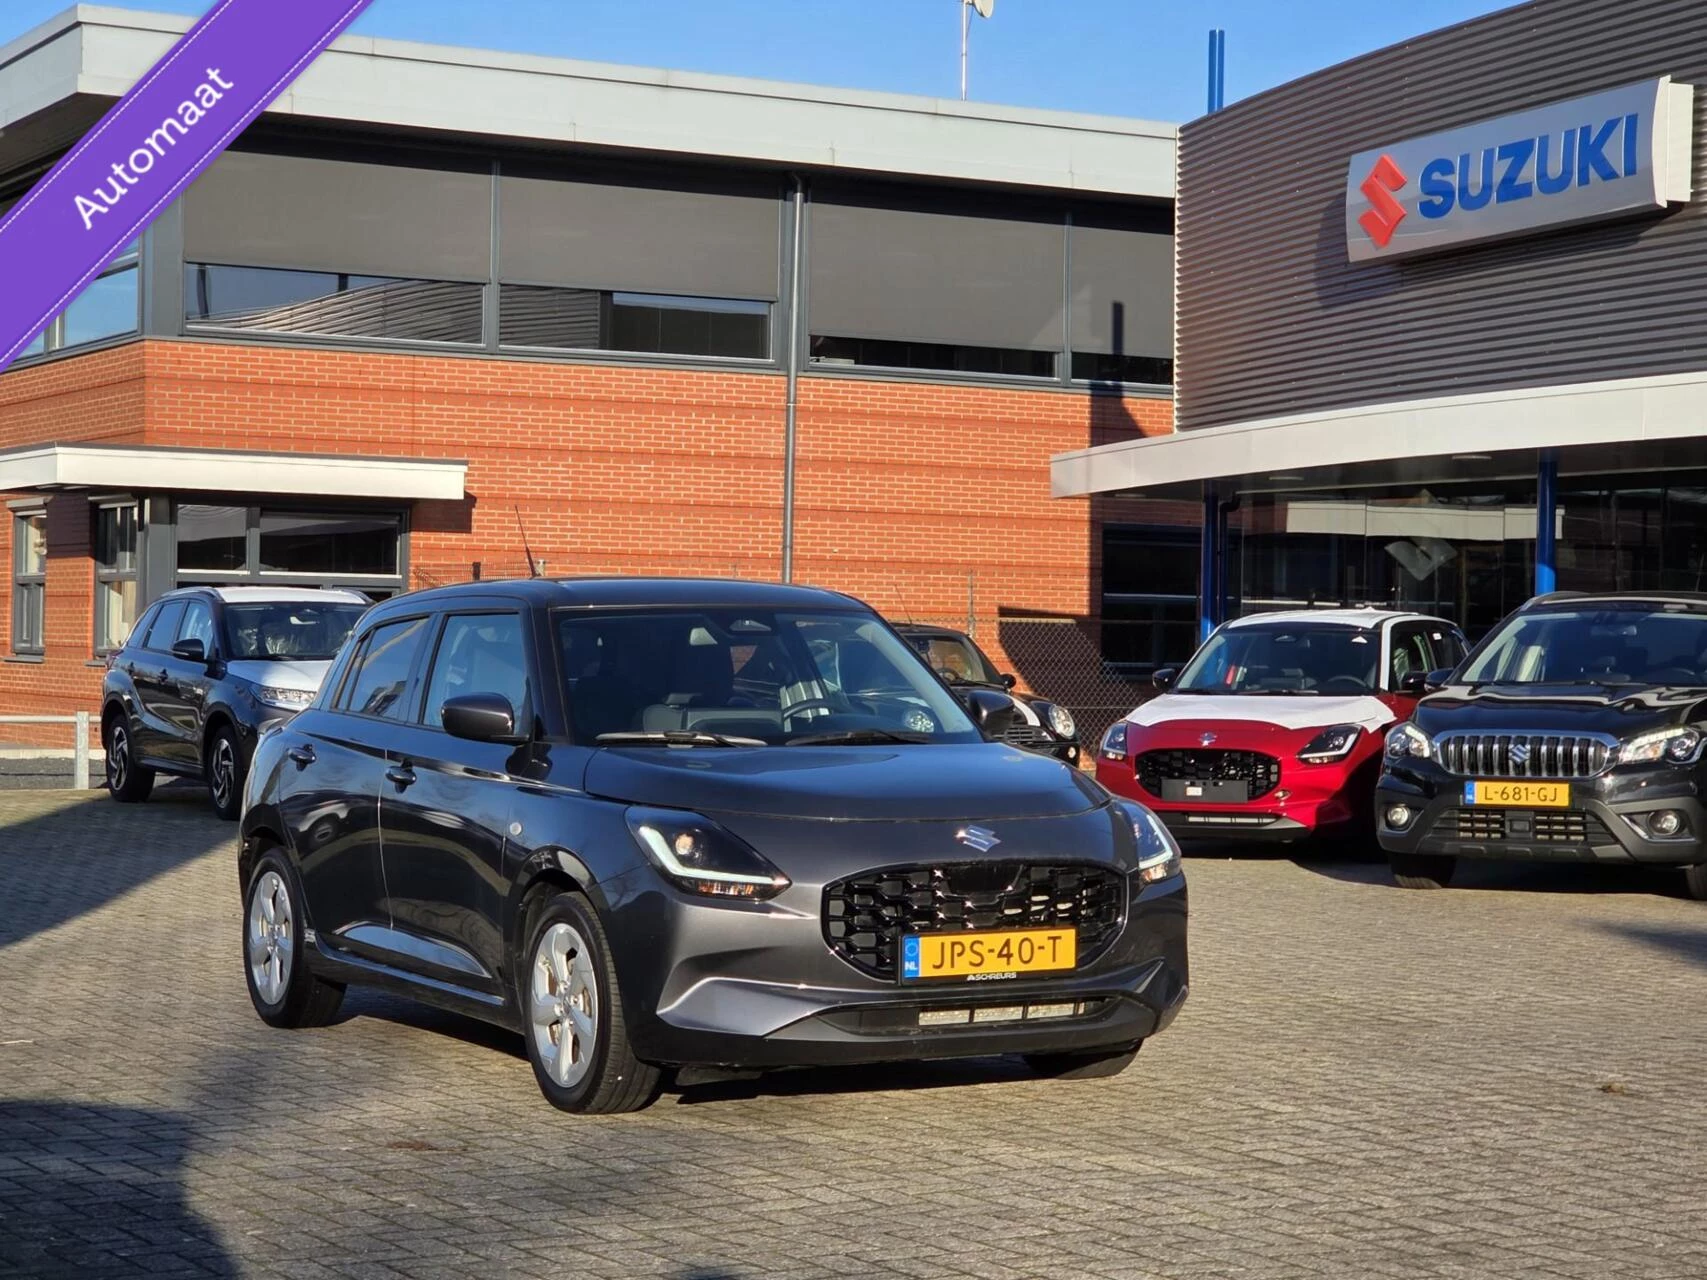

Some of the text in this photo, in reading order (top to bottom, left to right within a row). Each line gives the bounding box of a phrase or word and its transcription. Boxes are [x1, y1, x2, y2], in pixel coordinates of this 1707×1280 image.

[1417, 113, 1639, 219] SUZUKI
[1484, 786, 1558, 802] L-681-GJ
[904, 935, 1062, 971] NL JPS-40-T
